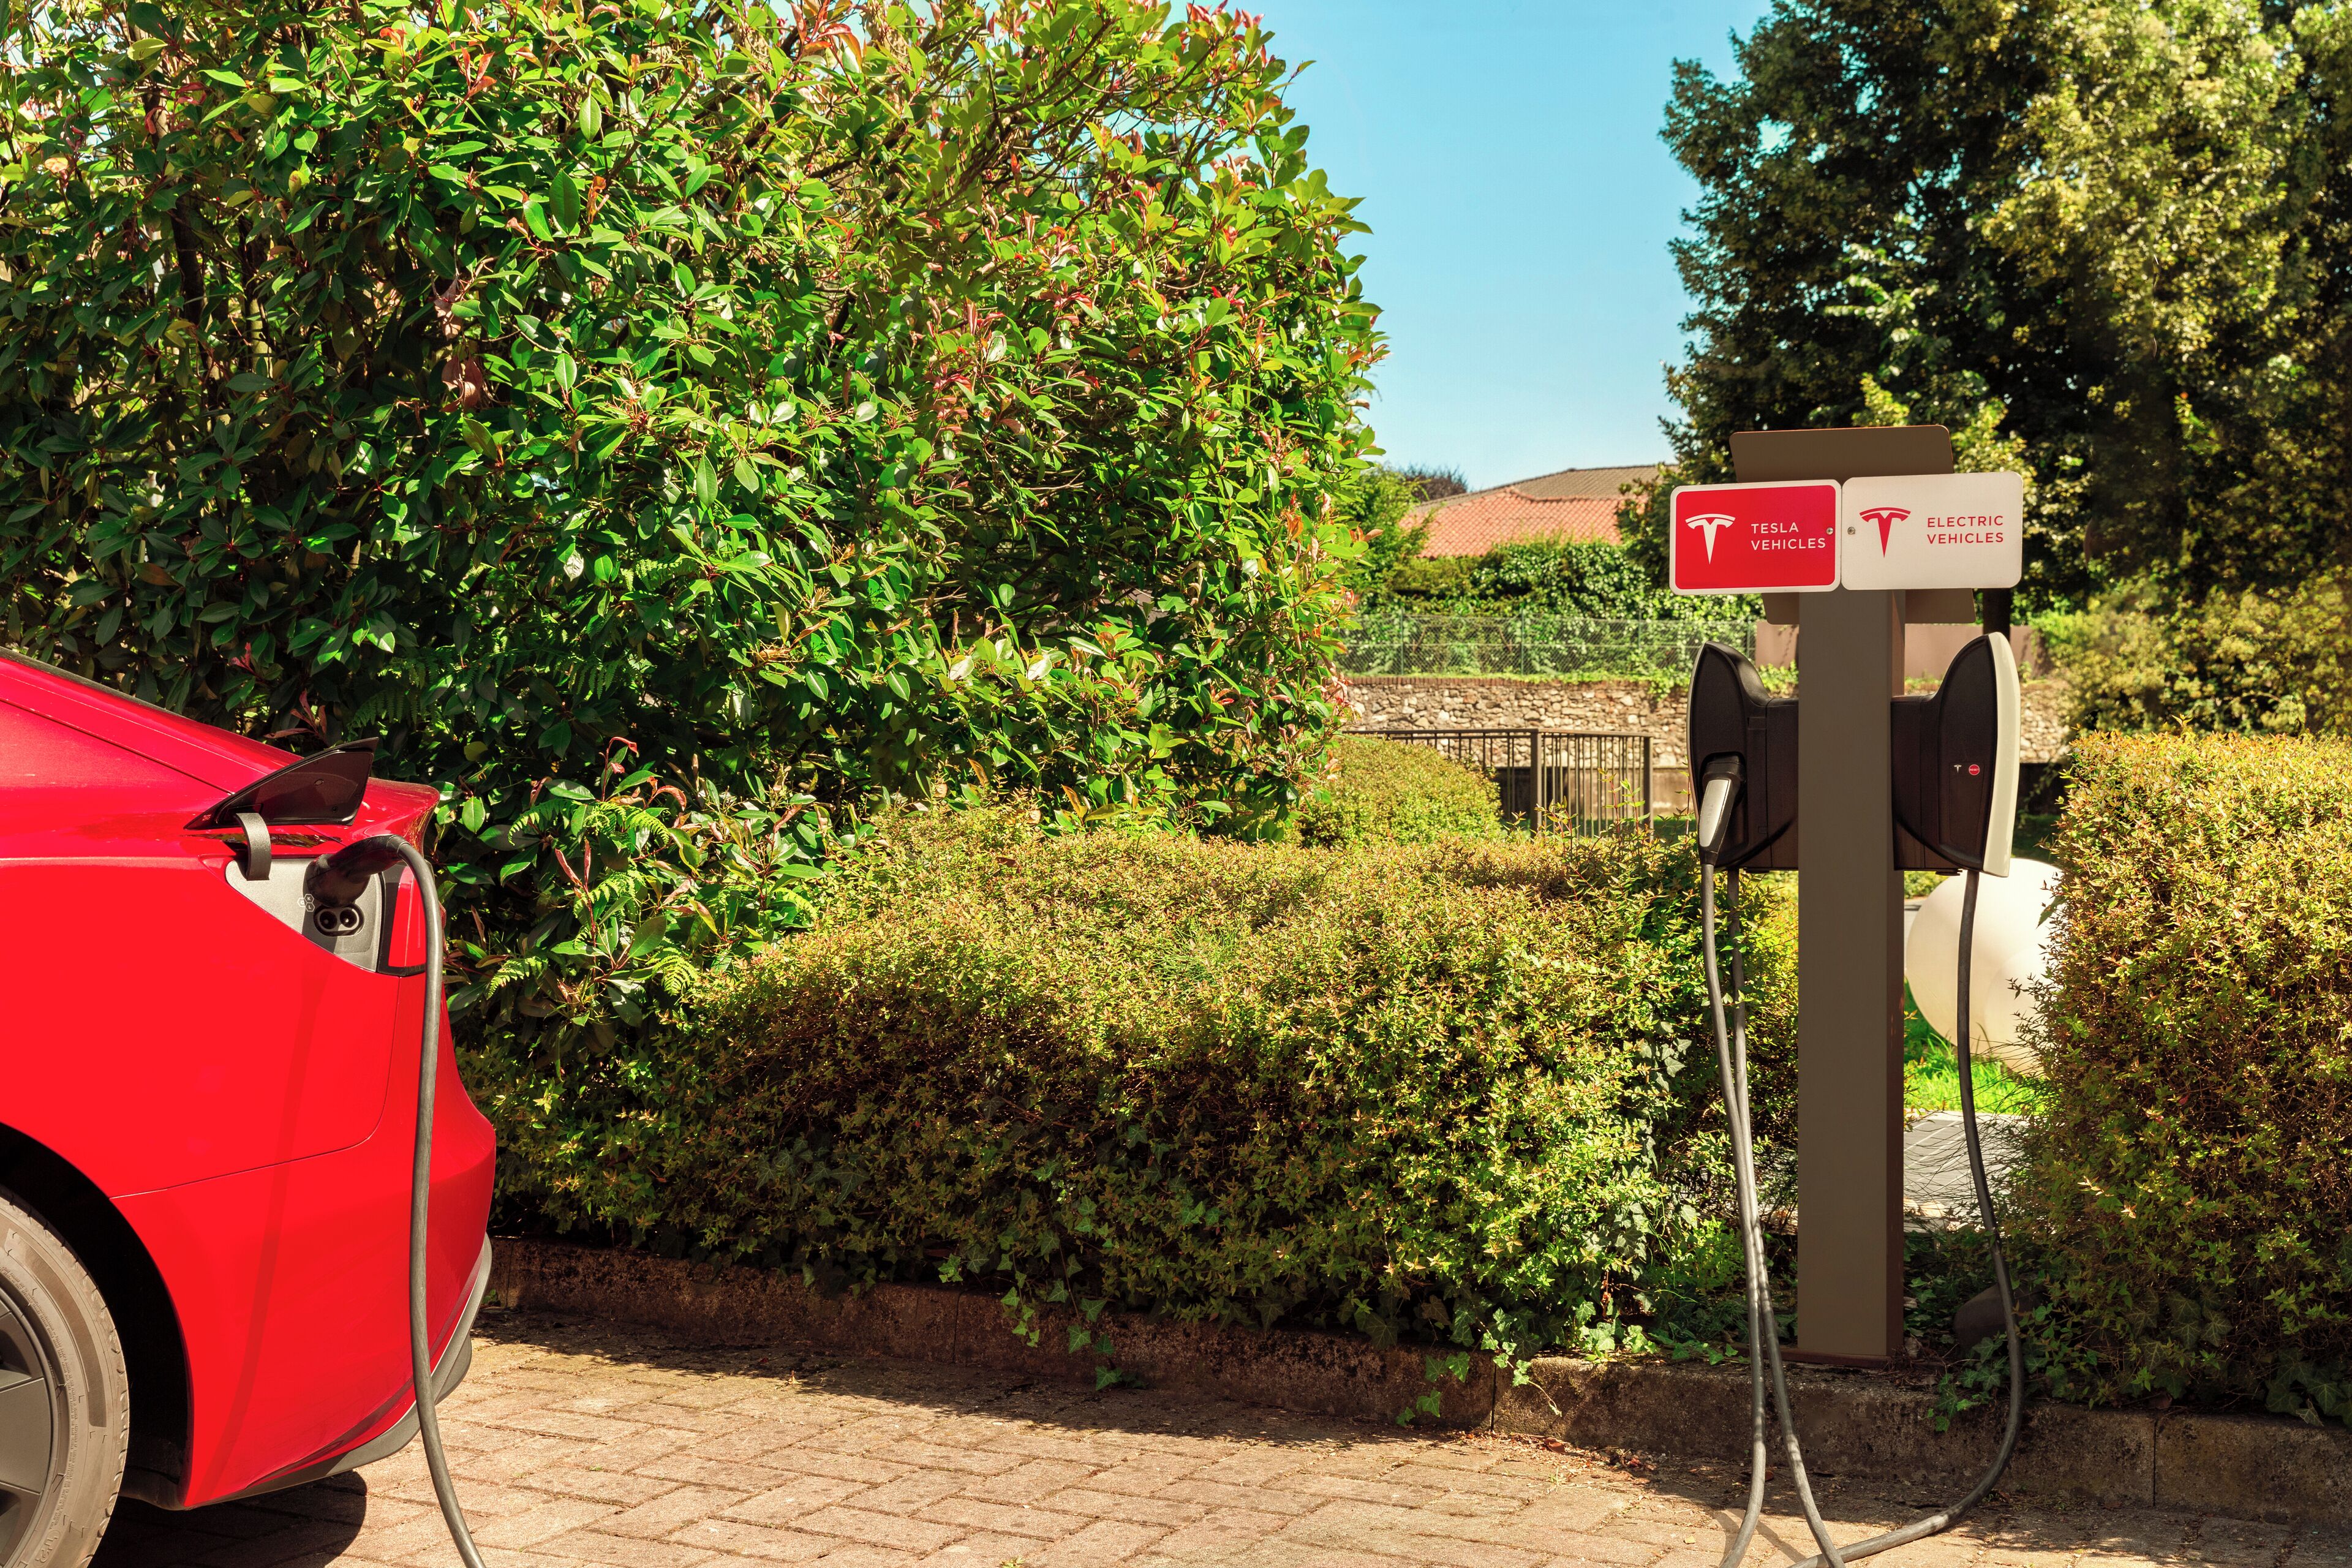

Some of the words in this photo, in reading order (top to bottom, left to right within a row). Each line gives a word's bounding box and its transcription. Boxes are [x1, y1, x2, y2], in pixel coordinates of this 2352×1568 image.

[1751, 522, 1799, 534] TESLA
[1928, 515, 2003, 528] ELECTRIC
[1751, 537, 1826, 551] VEHICLES
[1927, 532, 2004, 545] VEHICLES
